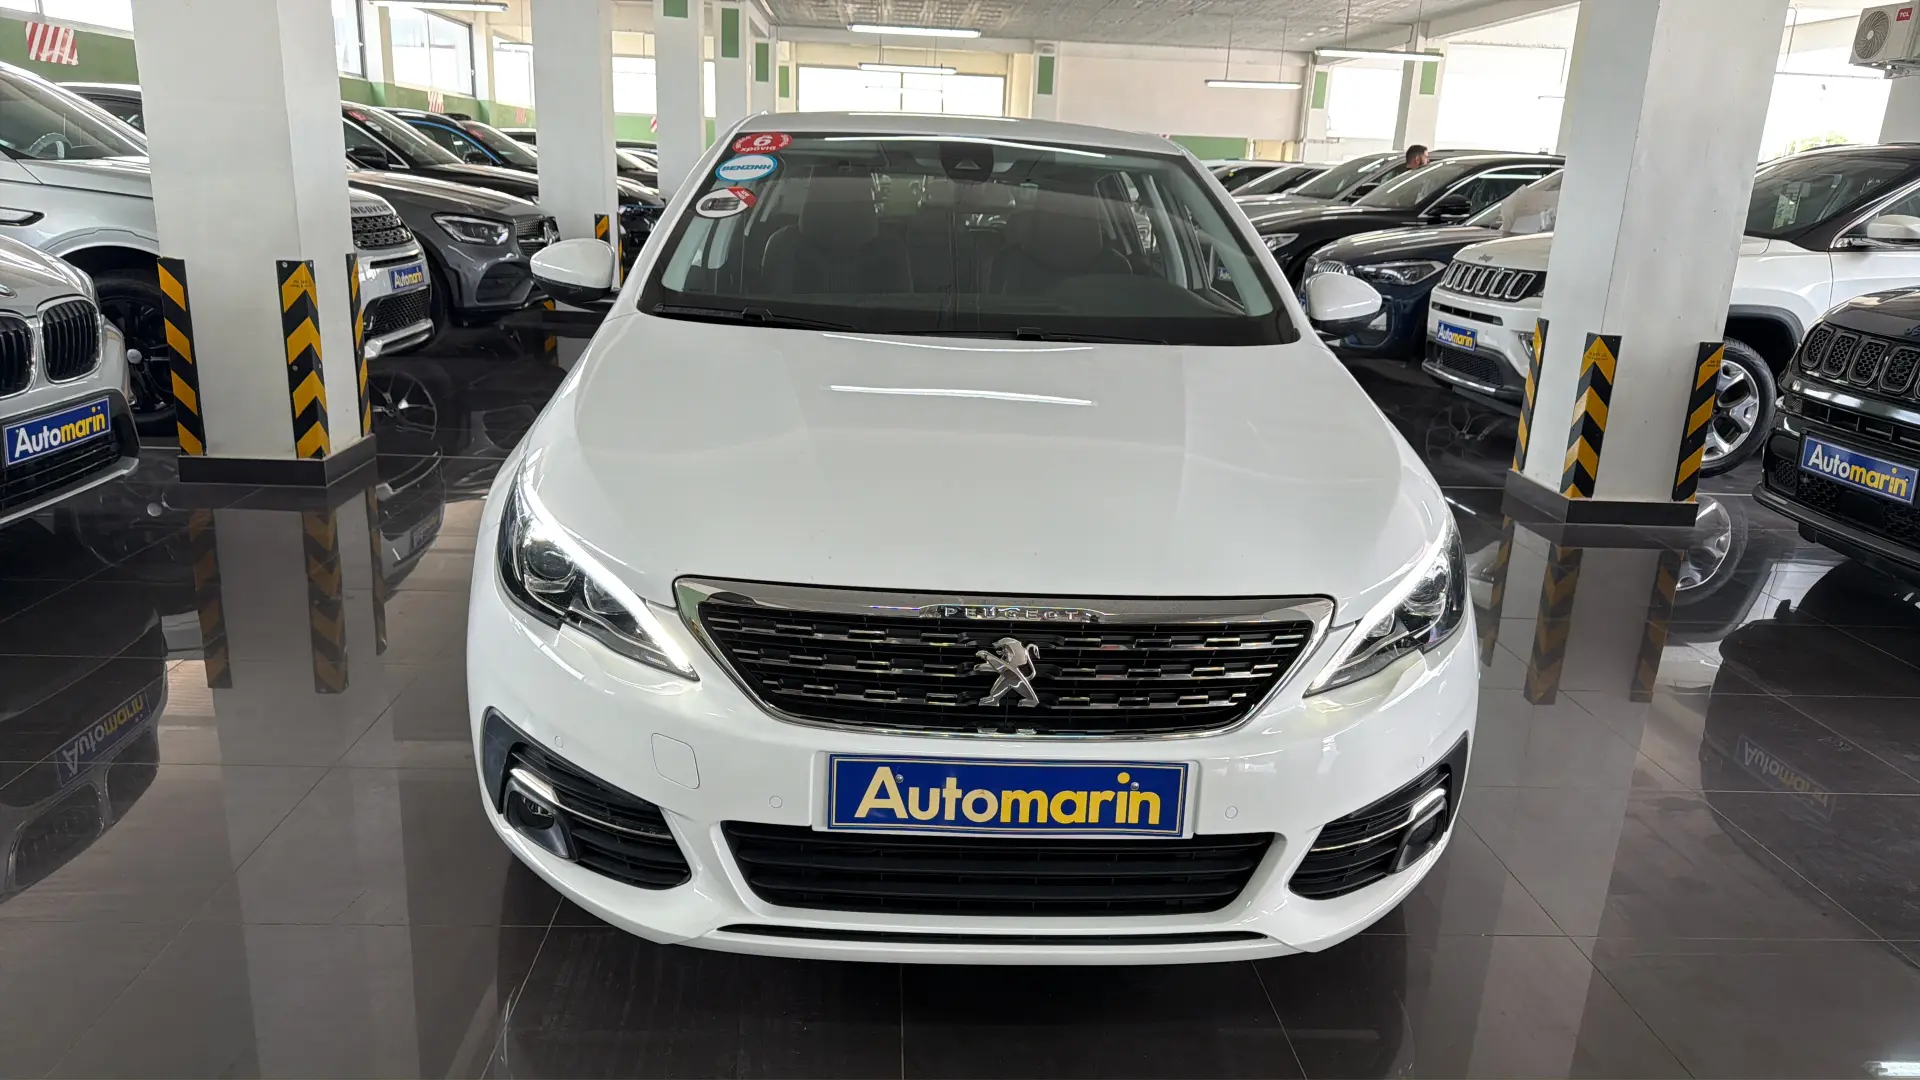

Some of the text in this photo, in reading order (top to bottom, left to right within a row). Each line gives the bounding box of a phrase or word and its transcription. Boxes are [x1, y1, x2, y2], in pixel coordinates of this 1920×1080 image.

[753, 134, 774, 147] 6
[394, 266, 422, 289] Automarin
[1437, 323, 1473, 348] Automarin
[14, 406, 106, 458] Automarin
[1807, 443, 1908, 497] Automarin
[943, 606, 1079, 620] PEUGEOT
[854, 766, 1160, 825] Automarin
